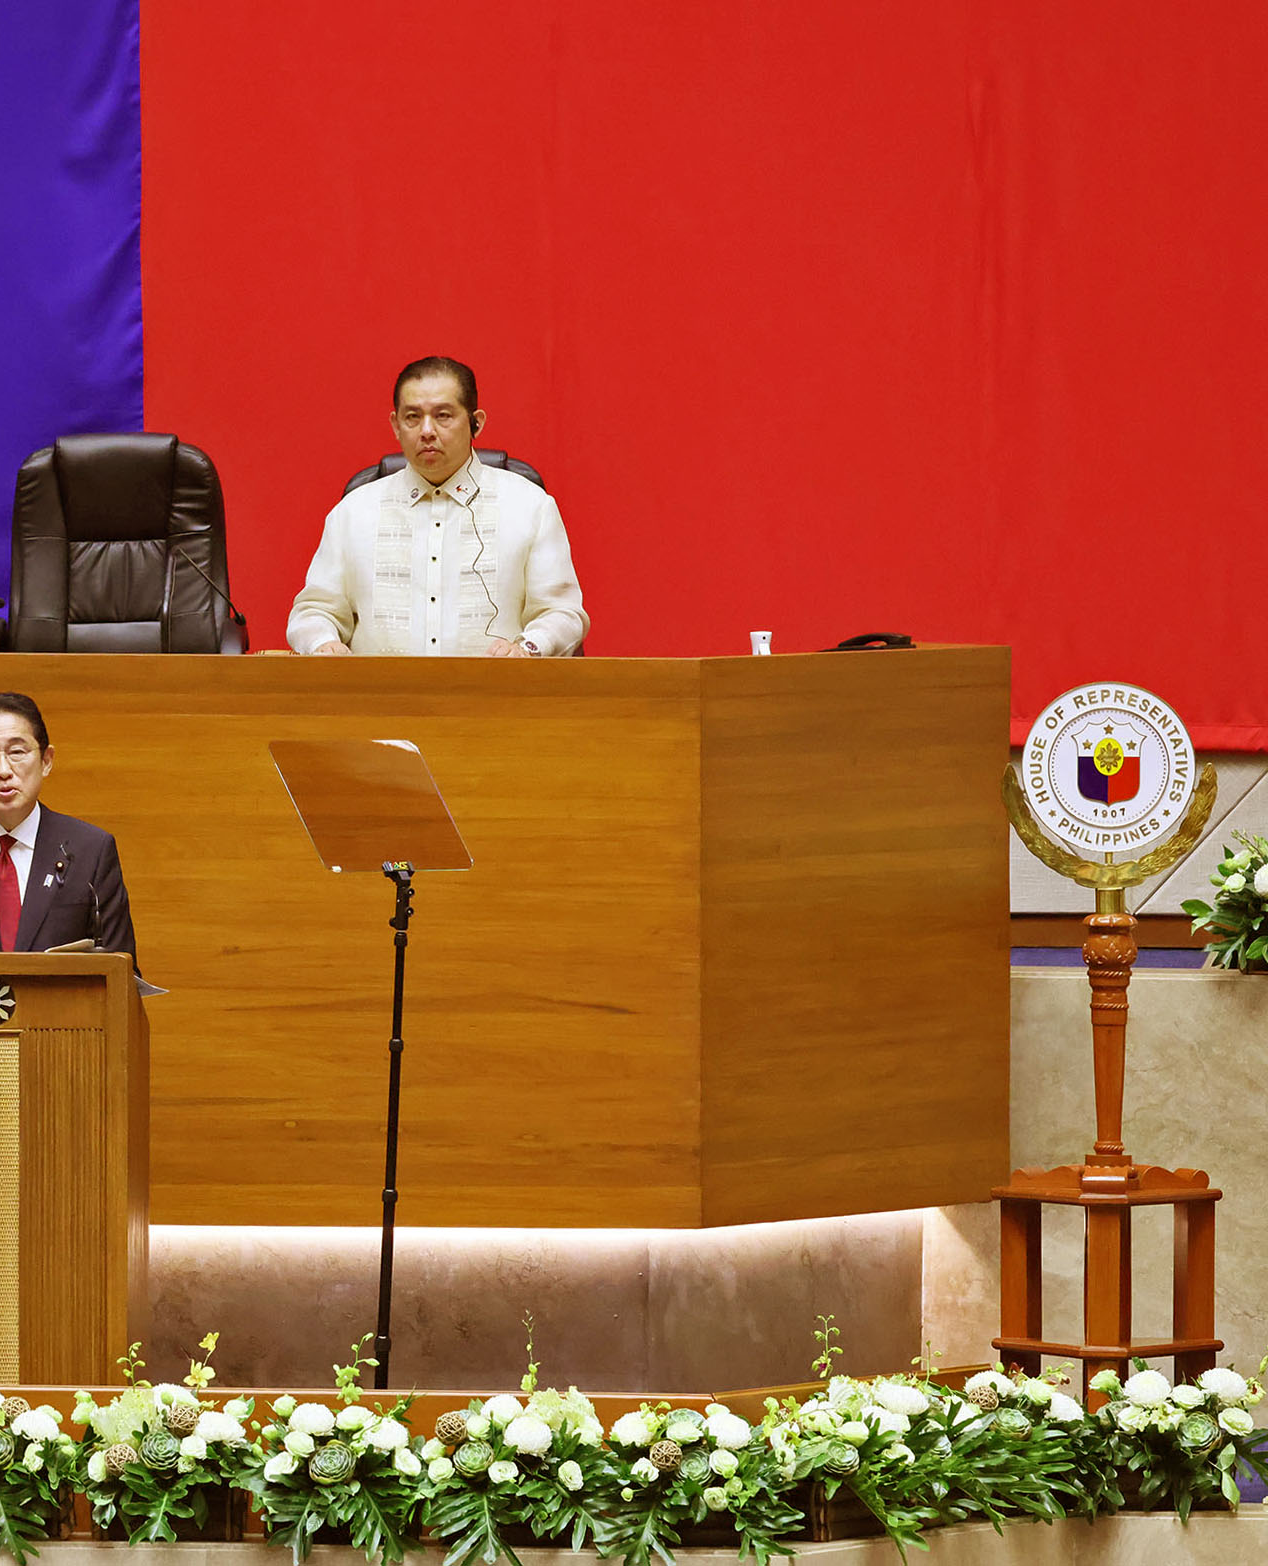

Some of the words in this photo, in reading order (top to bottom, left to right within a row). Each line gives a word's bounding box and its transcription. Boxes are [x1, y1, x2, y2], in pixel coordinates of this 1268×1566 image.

[1029, 736, 1050, 804] HOUSE
[1045, 706, 1066, 730] OF
[1073, 689, 1188, 803] REPRESENTATIVES
[1093, 807, 1126, 818] 1907
[1058, 818, 1160, 846] PHILIPPINES
